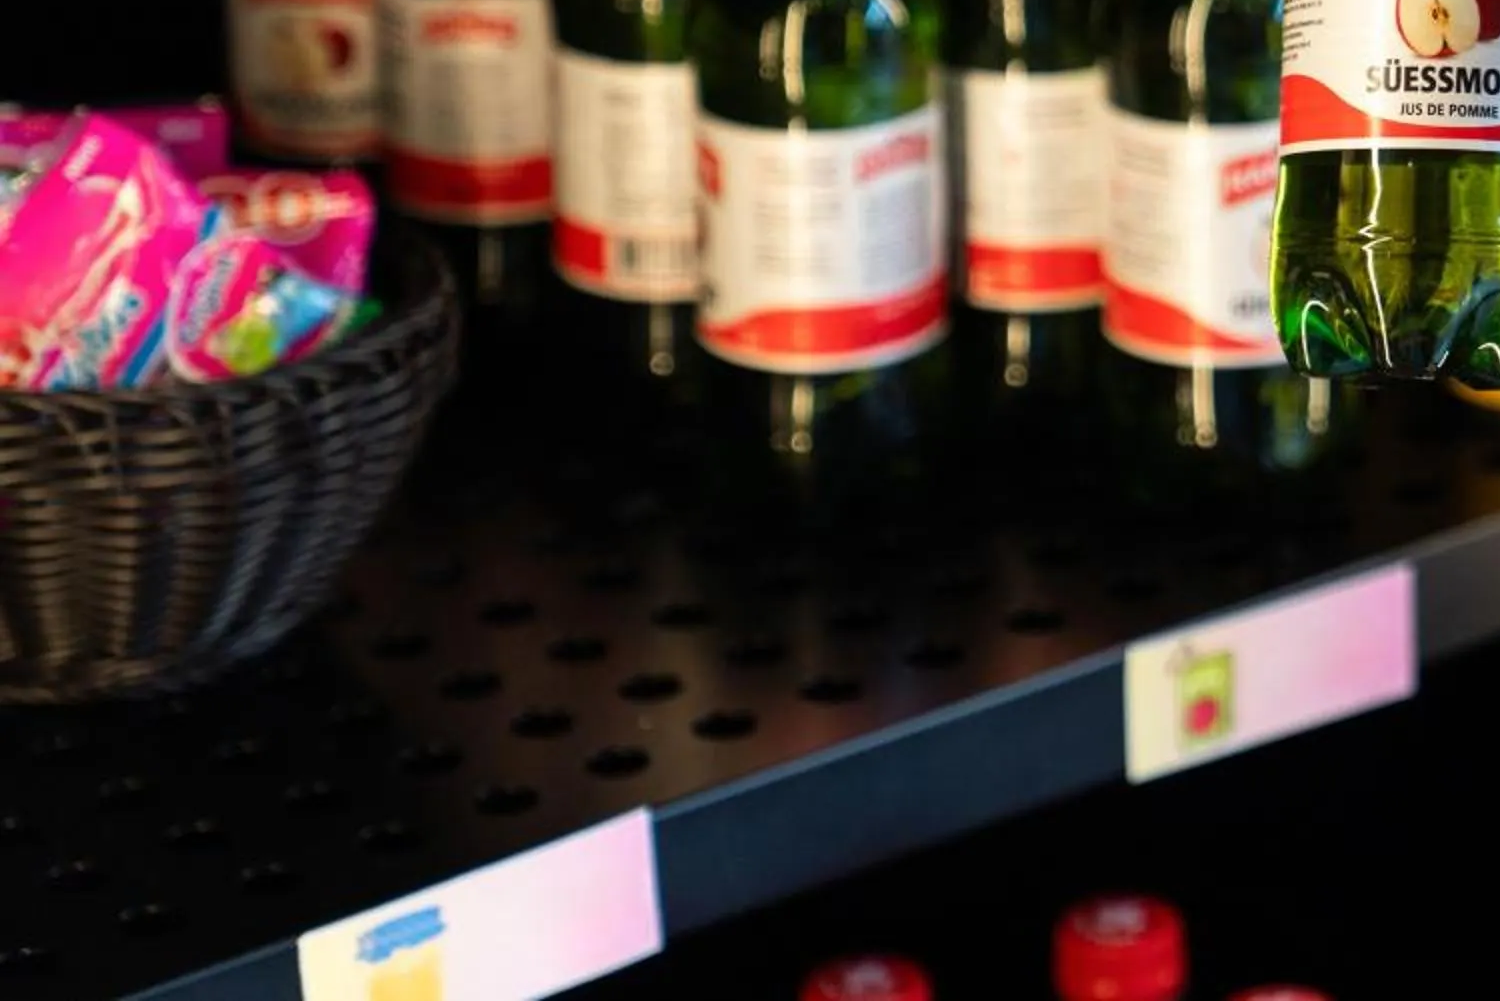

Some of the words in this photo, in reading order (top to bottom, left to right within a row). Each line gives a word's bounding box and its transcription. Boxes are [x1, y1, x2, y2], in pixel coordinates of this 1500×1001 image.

[1401, 102, 1423, 117] JUS
[1427, 103, 1445, 117] DE
[1449, 104, 1499, 119] POMME
